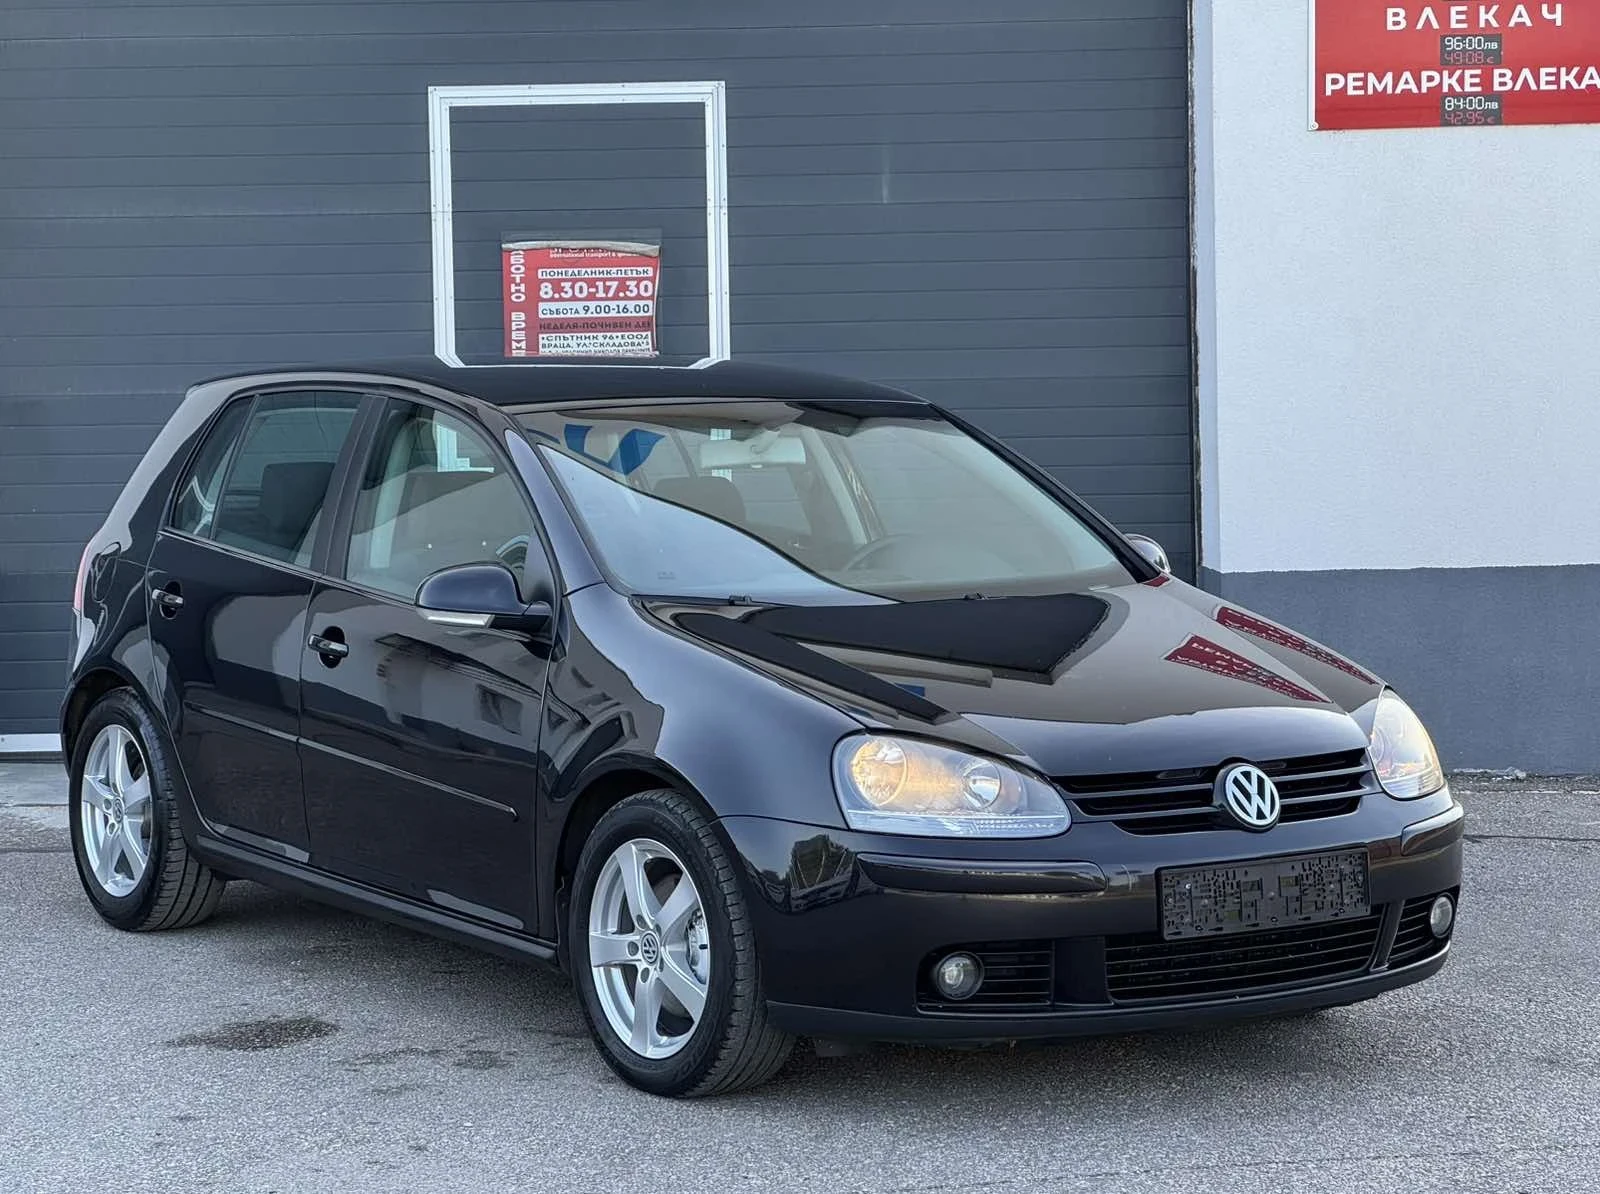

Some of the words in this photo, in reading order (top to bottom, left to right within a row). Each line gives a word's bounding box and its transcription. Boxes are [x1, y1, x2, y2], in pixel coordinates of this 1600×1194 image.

[1386, 3, 1562, 31] ВЛЕКАЧ
[1325, 69, 1482, 96] РЕМАРКЕ
[539, 280, 653, 299] 8.30-17.30
[541, 308, 580, 316] СЪБОТА
[583, 304, 650, 314] 9.00-16.00
